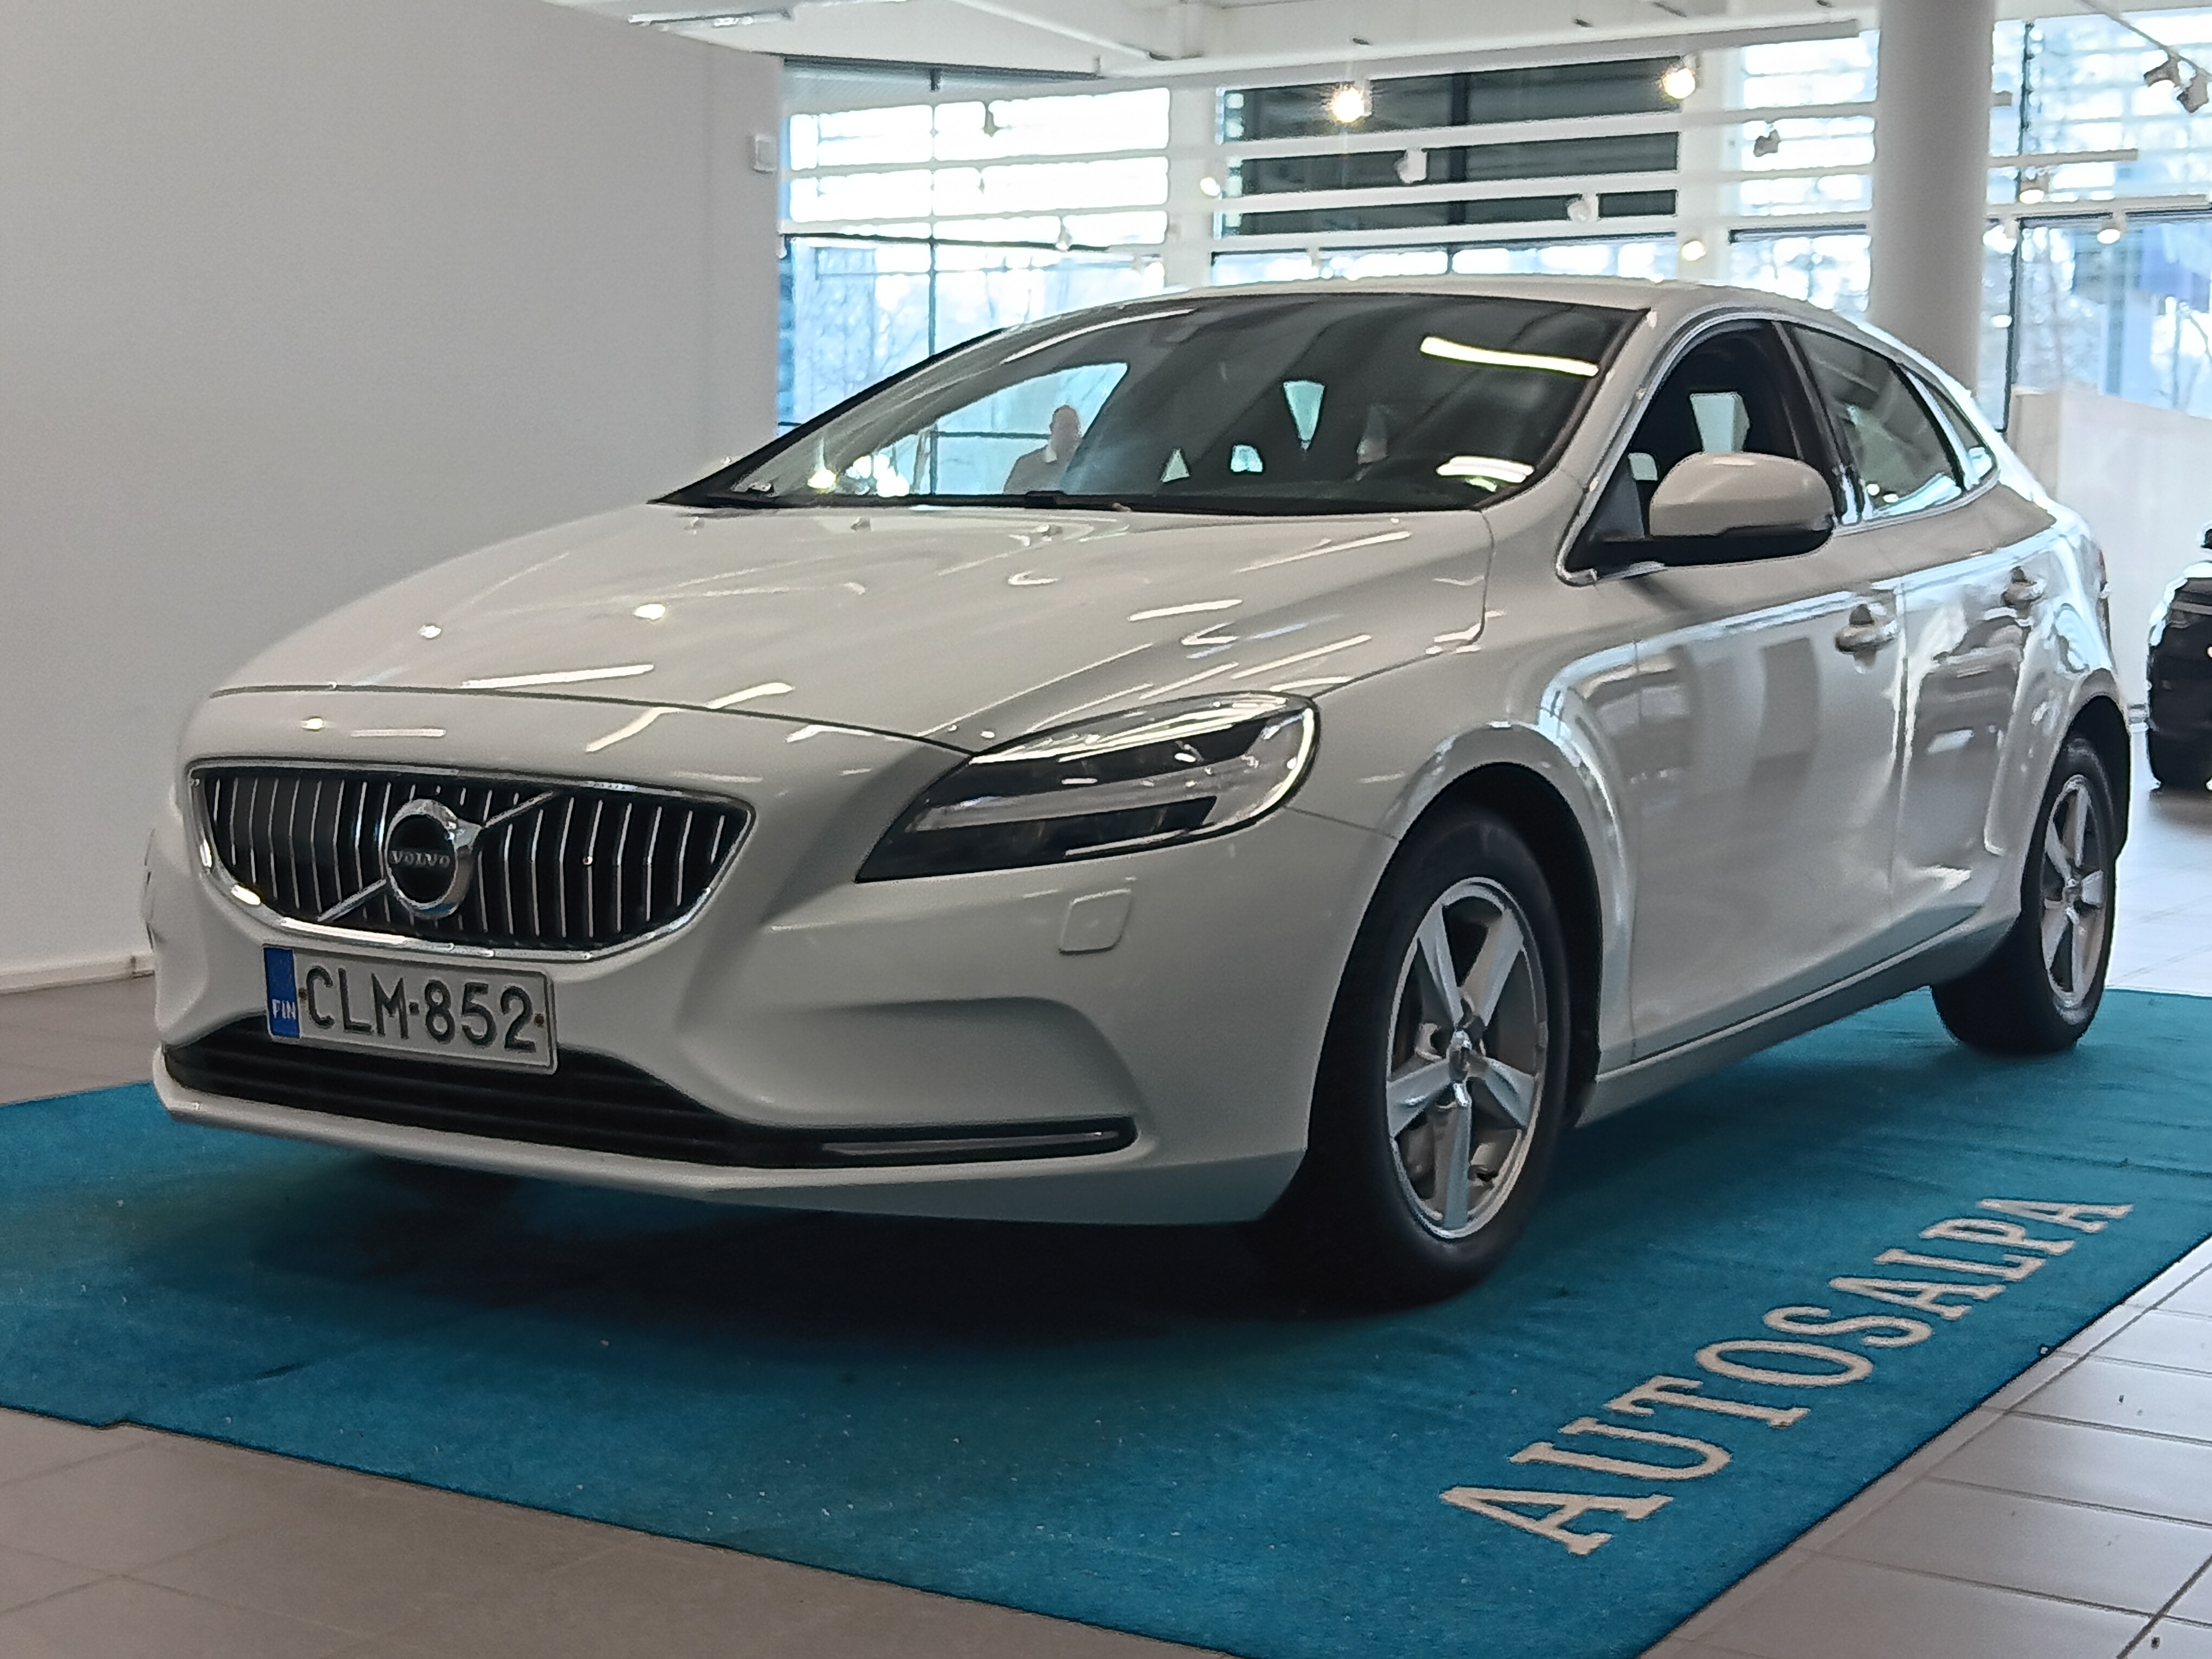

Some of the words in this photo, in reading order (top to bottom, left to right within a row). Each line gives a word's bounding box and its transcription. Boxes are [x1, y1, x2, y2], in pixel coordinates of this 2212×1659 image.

[389, 850, 451, 868] VOLVO
[272, 998, 297, 1020] FIN
[305, 964, 537, 1053] CLM-852
[1438, 1198, 2134, 1556] AUTOSALPA
